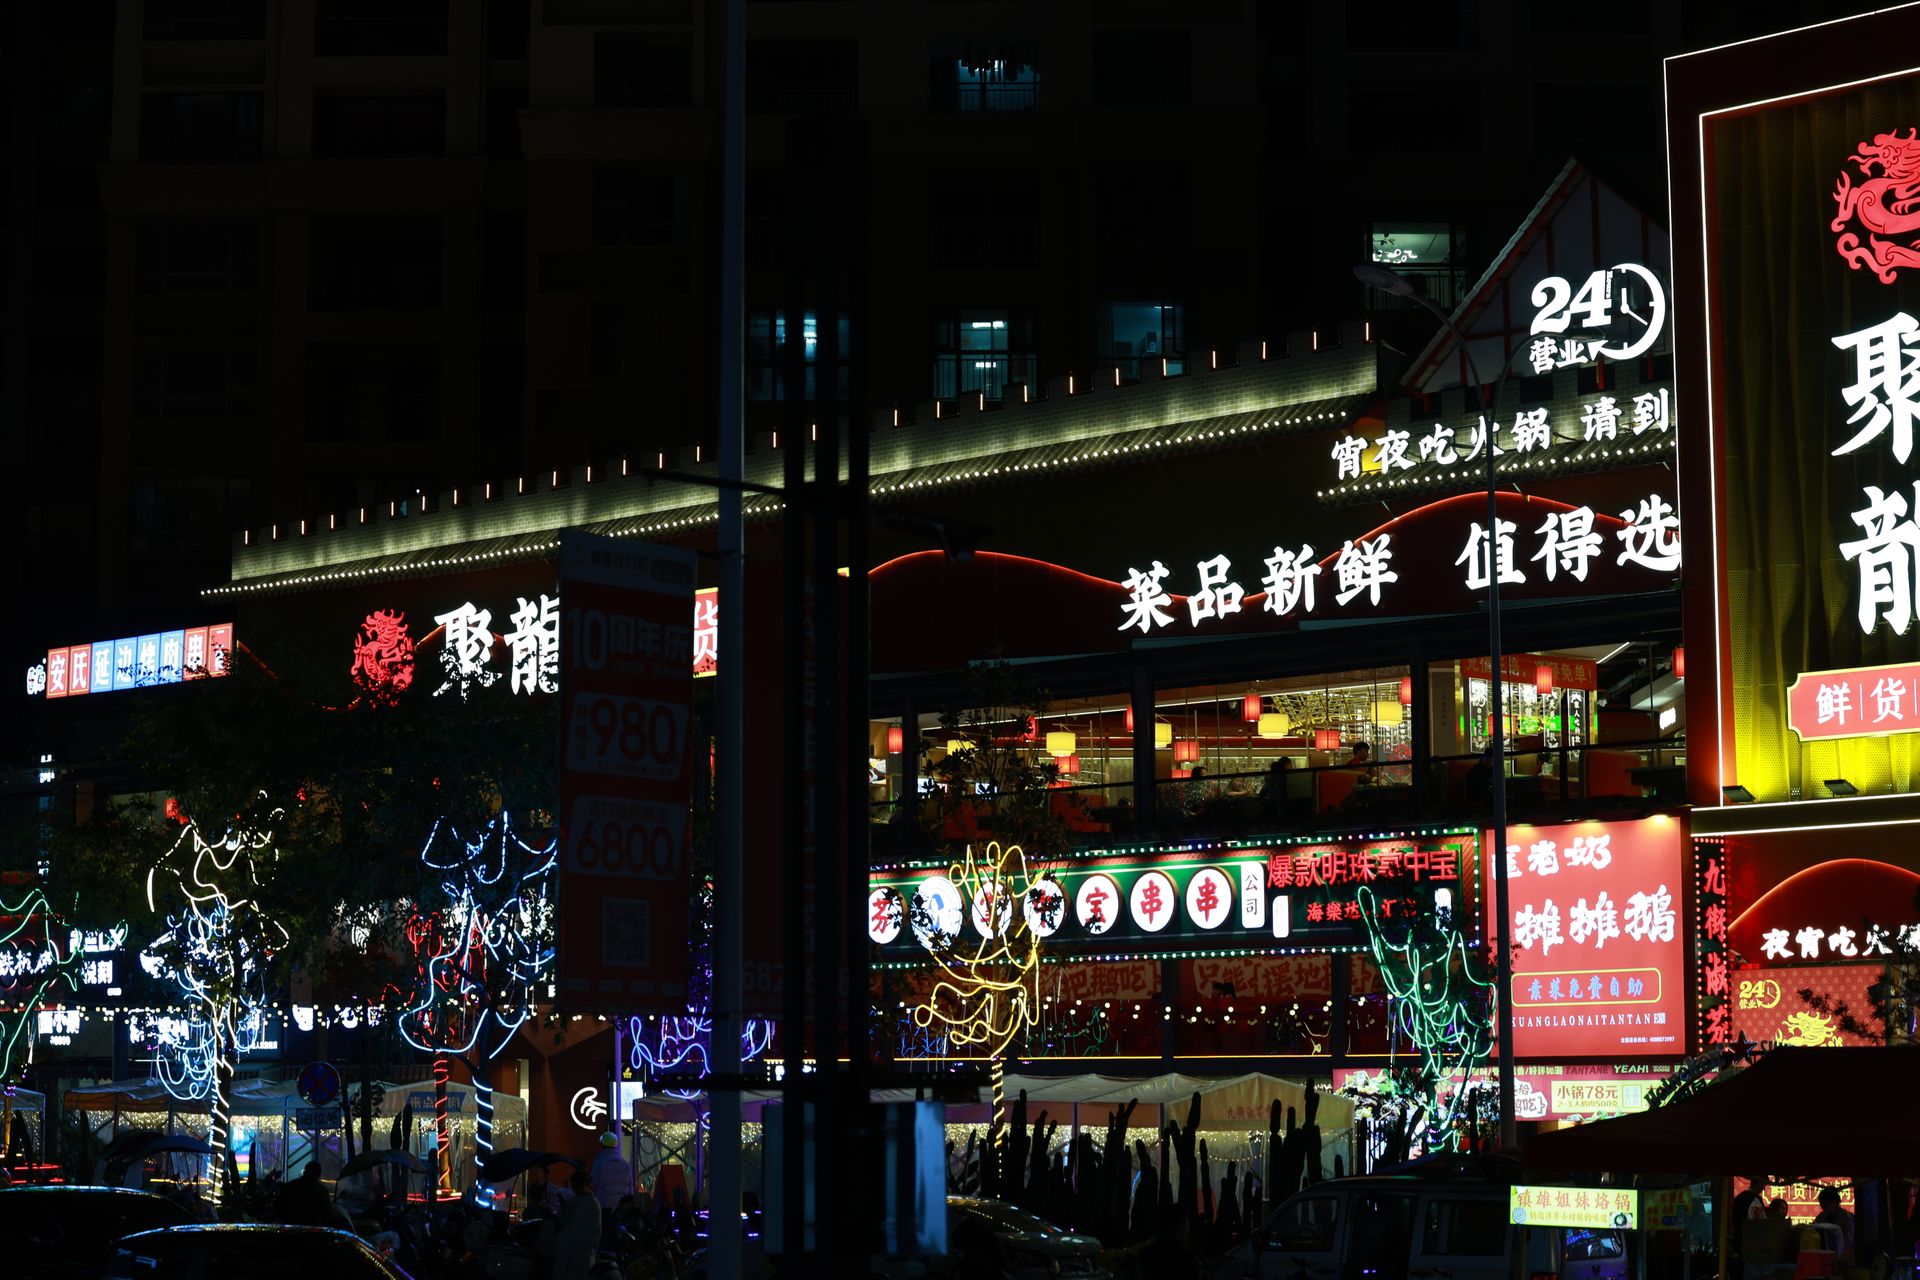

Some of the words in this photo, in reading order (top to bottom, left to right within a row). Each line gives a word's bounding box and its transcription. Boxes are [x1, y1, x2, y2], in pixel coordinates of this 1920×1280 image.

[1530, 269, 1612, 336] 24
[1529, 336, 1589, 374] 营业
[1332, 407, 1550, 480] 宵夜吃火锅
[1580, 388, 1669, 442] 请到
[1118, 533, 1398, 634] 菜品新鲜
[1455, 493, 1681, 591] 值得选
[591, 700, 677, 764] 980
[577, 821, 673, 876] 6800
[1244, 873, 1259, 916] 公司
[1704, 858, 1728, 1045] 九街淑芬
[1557, 1085, 1619, 1100] 小锅78元
[1614, 1064, 1649, 1074] YEAH!
[1517, 1189, 1631, 1212] 镇雄姐妹烙锅
